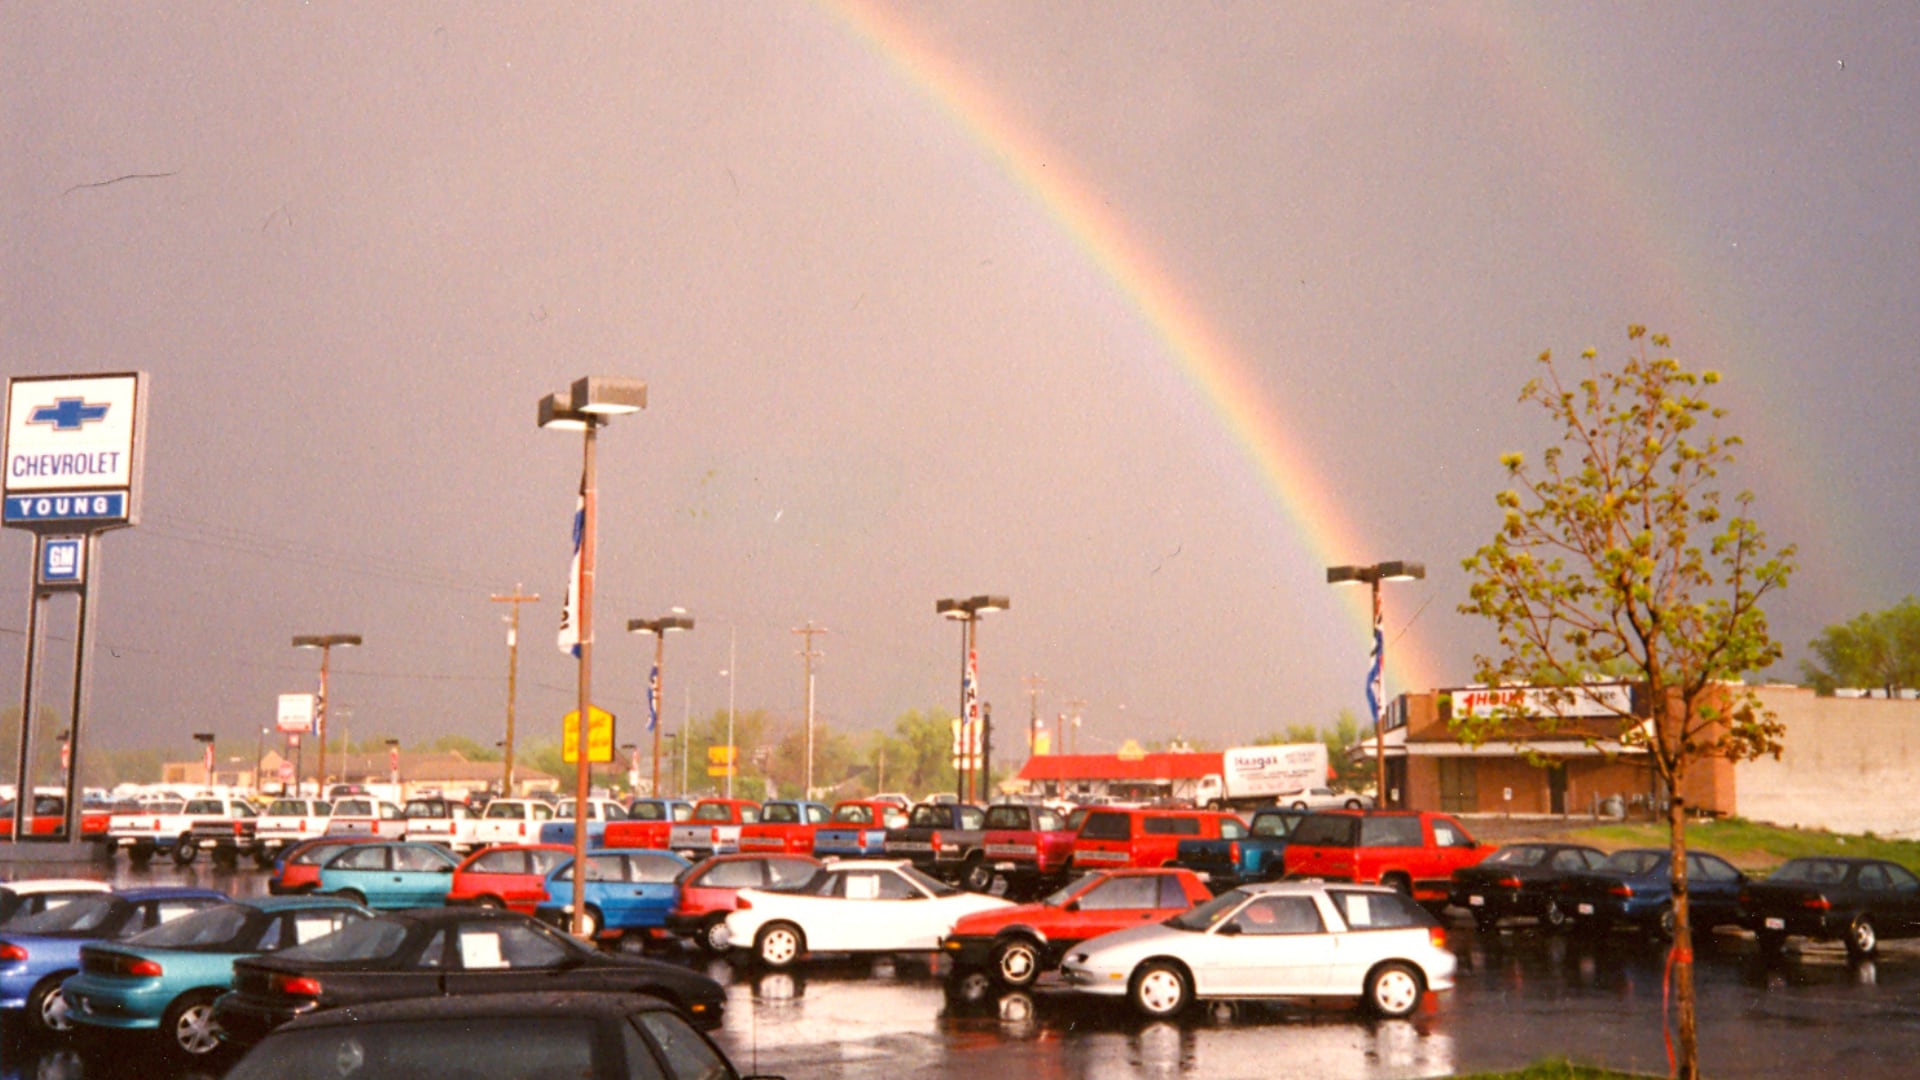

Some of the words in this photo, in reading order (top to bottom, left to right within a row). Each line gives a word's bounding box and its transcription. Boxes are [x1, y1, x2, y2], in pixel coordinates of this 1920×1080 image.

[12, 452, 120, 477] CHEVROLET
[20, 497, 108, 516] YOUNG
[49, 545, 75, 568] GM
